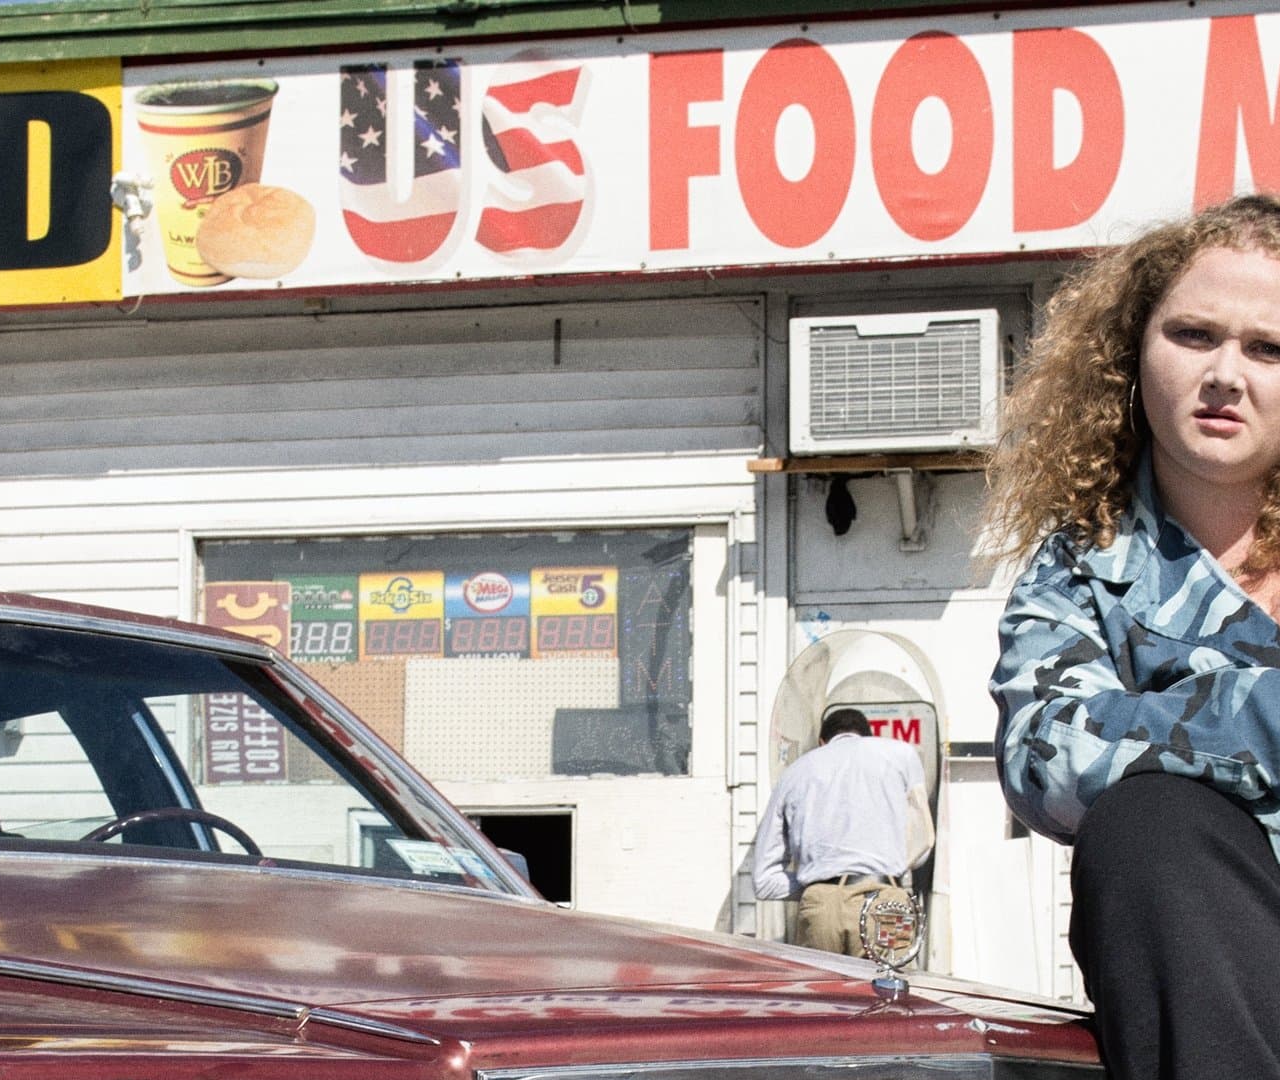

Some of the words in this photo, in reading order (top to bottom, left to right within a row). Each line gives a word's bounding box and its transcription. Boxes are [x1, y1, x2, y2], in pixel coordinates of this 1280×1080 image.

[339, 47, 593, 270] US
[648, 27, 1126, 251] FOOD
[580, 573, 606, 609] 5
[209, 692, 239, 733] SIZE
[868, 718, 921, 745] TM
[243, 694, 280, 775] COFFE
[211, 739, 242, 774] ANY
